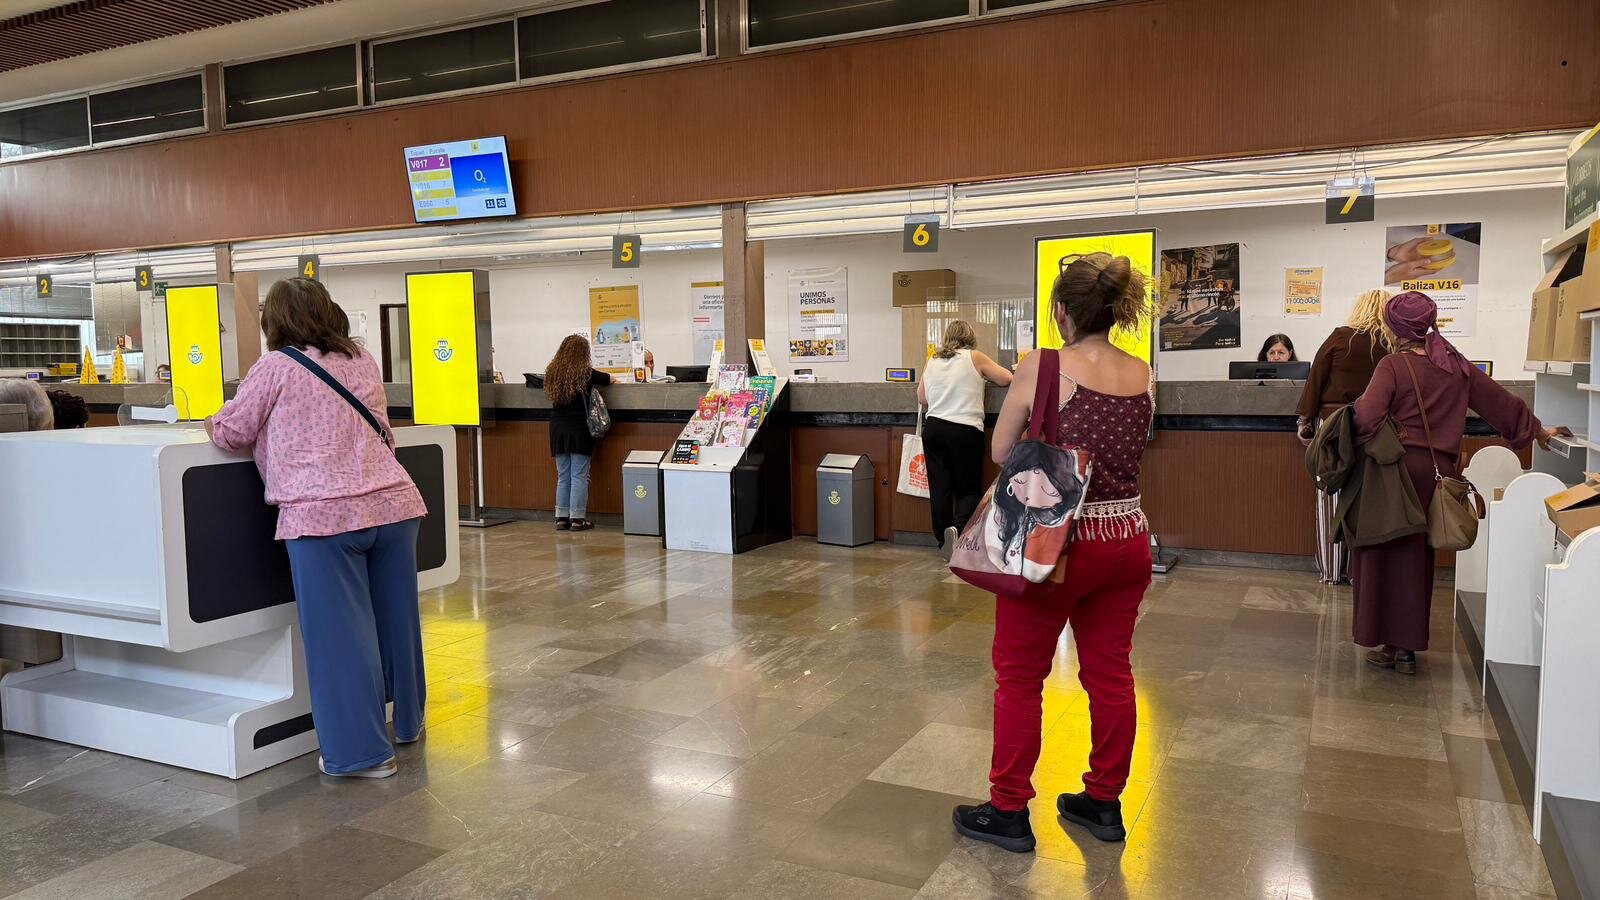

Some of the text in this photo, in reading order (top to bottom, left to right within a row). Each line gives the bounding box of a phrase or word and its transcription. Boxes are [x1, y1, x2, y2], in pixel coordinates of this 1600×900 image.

[410, 156, 445, 168] V017 2
[1340, 189, 1361, 215] 7
[912, 223, 930, 246] 6
[621, 242, 633, 262] 5
[304, 261, 315, 278] 4
[40, 279, 49, 294] 2
[140, 271, 148, 288] 3
[1402, 280, 1460, 291] Baliza V16
[800, 291, 827, 299] UNIMOS
[800, 297, 836, 305] PERSONAS
